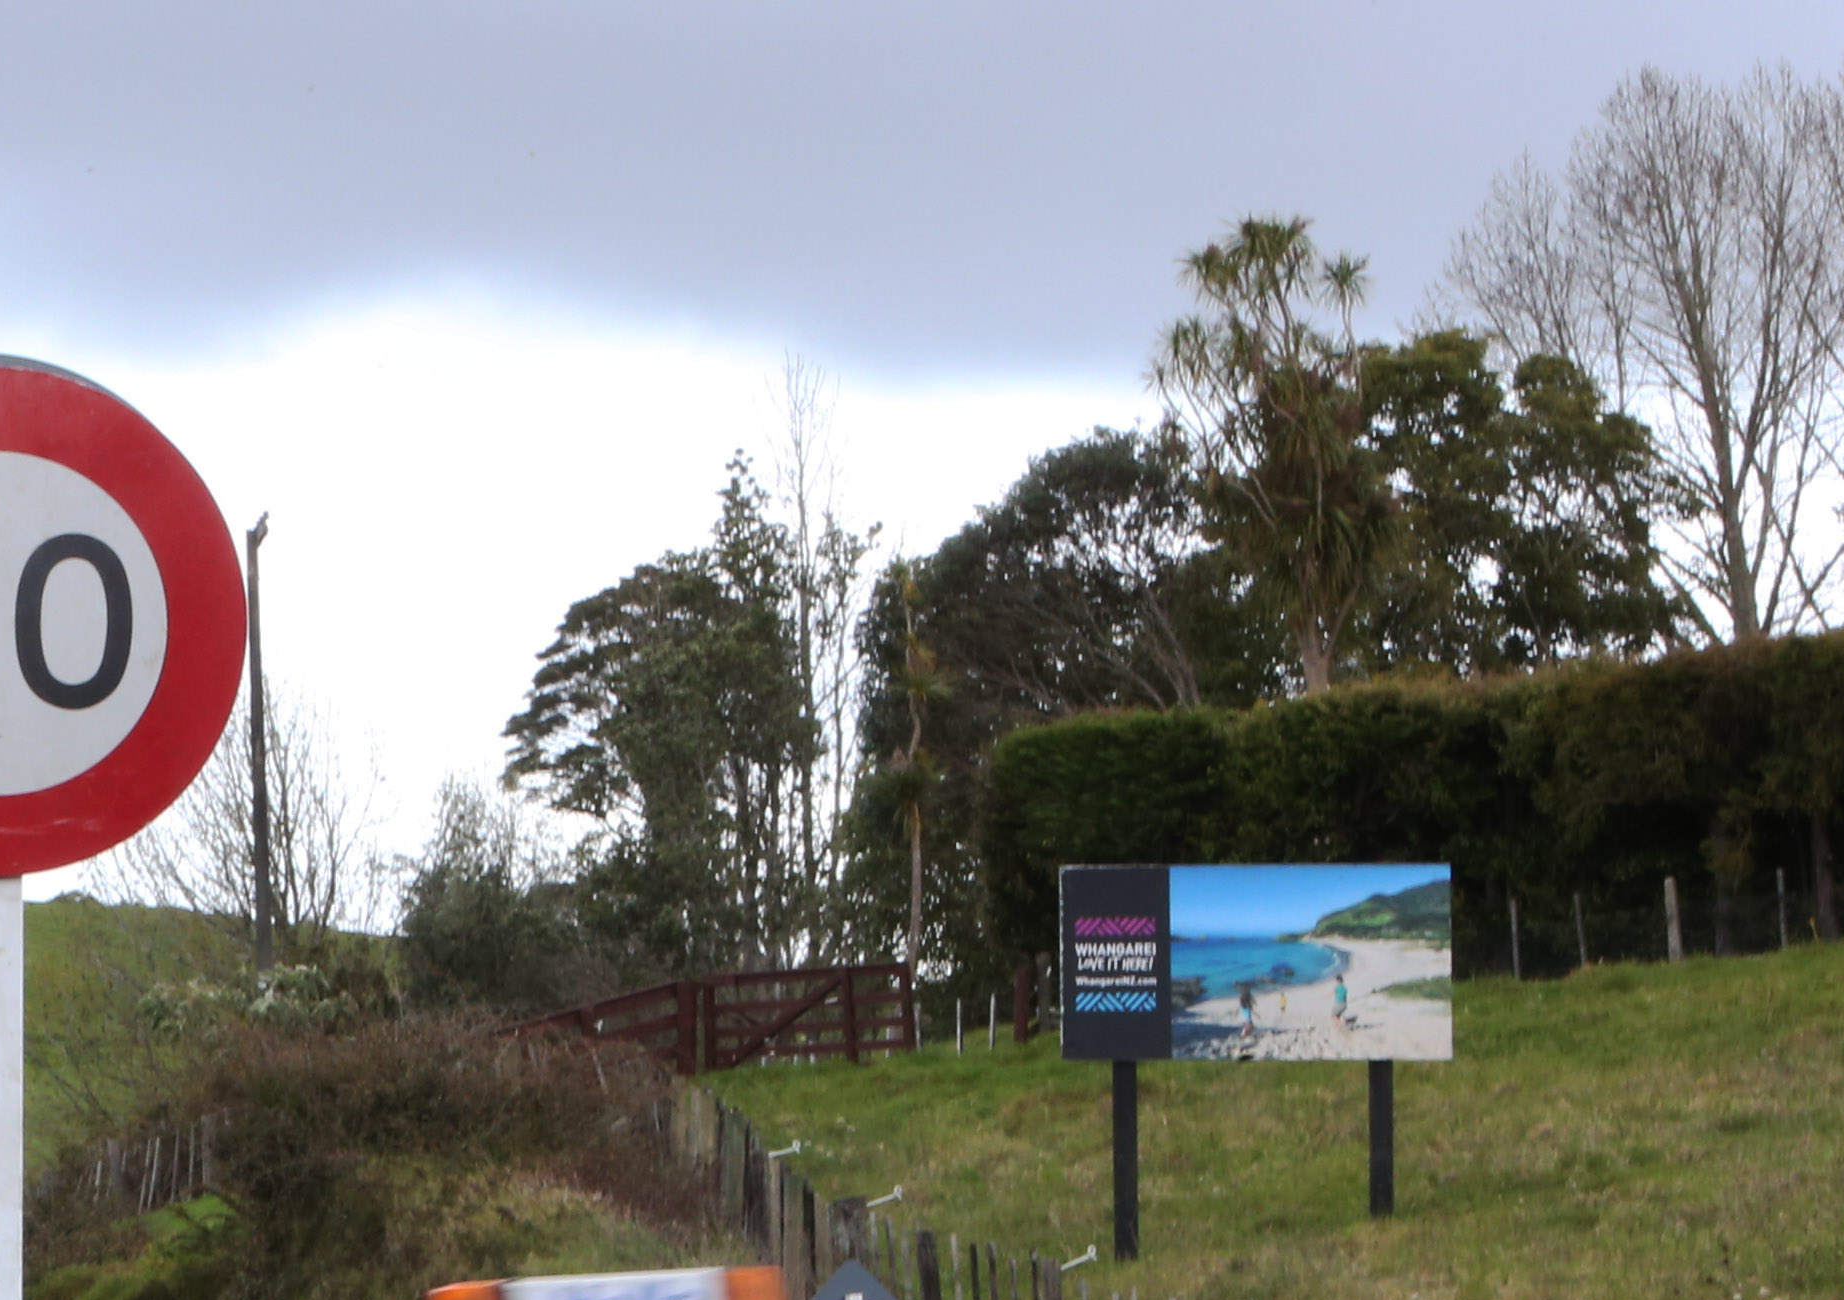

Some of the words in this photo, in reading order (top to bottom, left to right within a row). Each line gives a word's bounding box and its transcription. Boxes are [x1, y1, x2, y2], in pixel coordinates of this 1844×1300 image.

[1074, 941, 1157, 957] WHANGAREI
[1077, 956, 1105, 972] LOVE
[1107, 956, 1119, 972] IT
